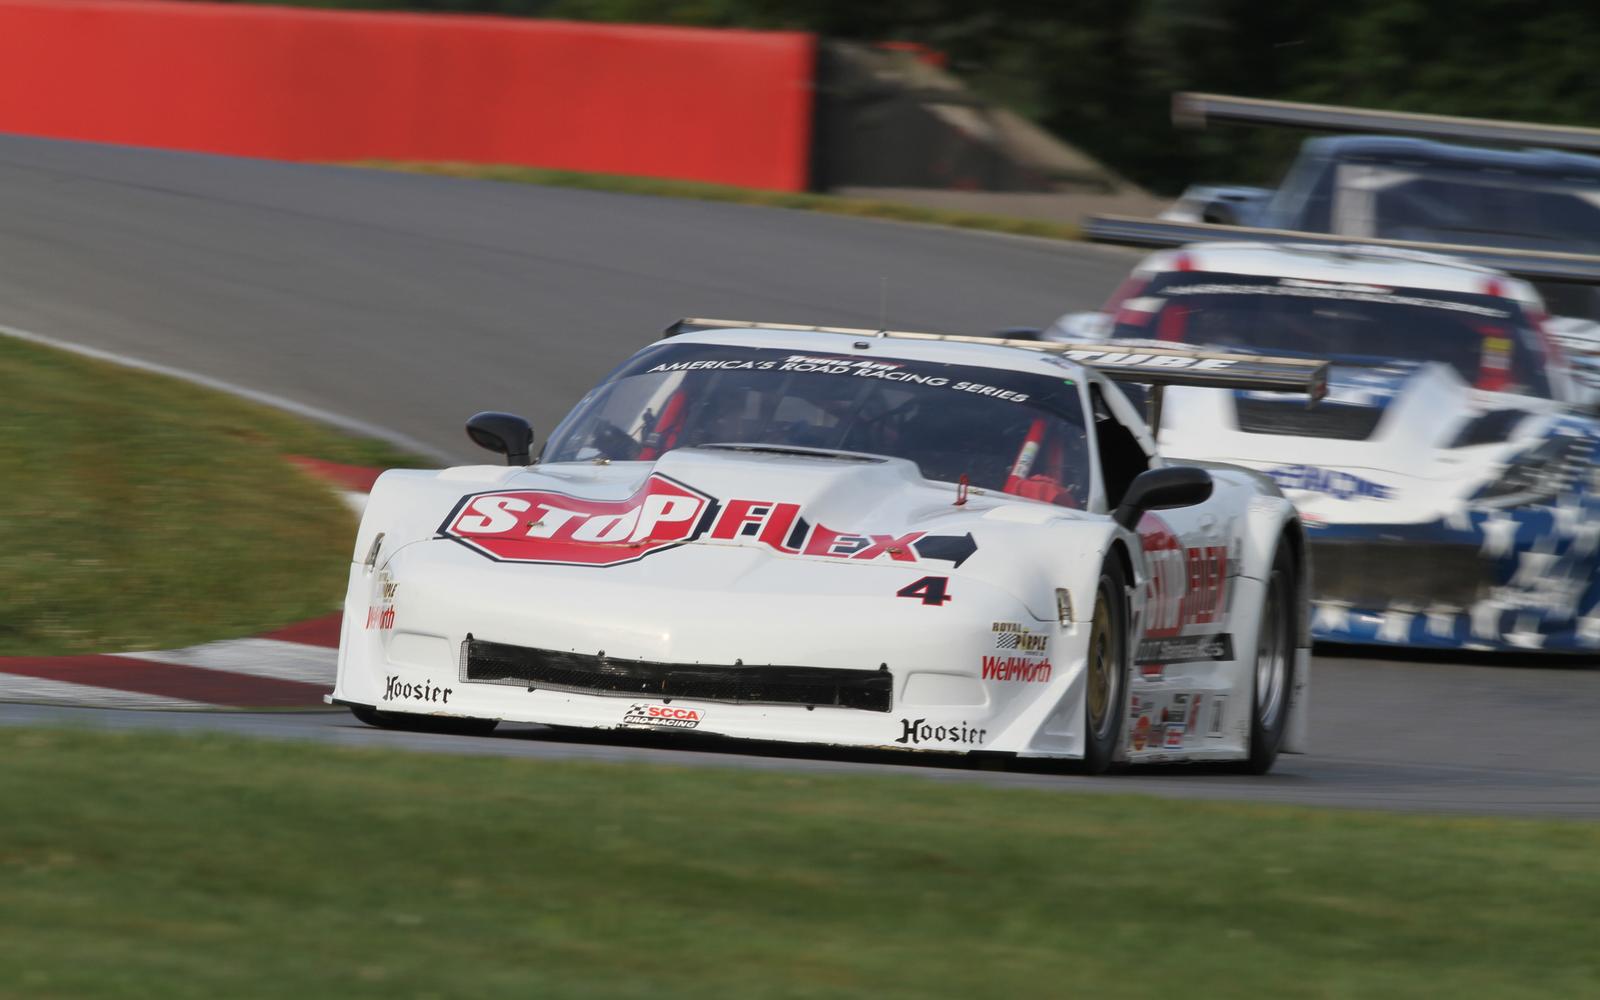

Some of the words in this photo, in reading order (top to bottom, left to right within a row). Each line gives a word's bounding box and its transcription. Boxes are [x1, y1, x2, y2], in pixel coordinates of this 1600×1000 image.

[851, 360, 900, 371] Am
[1064, 350, 1238, 370] TUBE
[647, 360, 777, 374] AMERICA'S
[779, 362, 852, 375] ROAD
[853, 367, 950, 387] RACING
[952, 381, 1030, 403] SERIES
[455, 494, 702, 543] STOP
[710, 498, 929, 563] FLEX
[896, 575, 952, 606] 4
[991, 621, 1021, 633] ROYAL
[382, 675, 453, 704] Hoosier
[624, 715, 697, 728] PRO-RACING
[648, 706, 700, 721] SCCA
[894, 718, 987, 745] Hoosier
